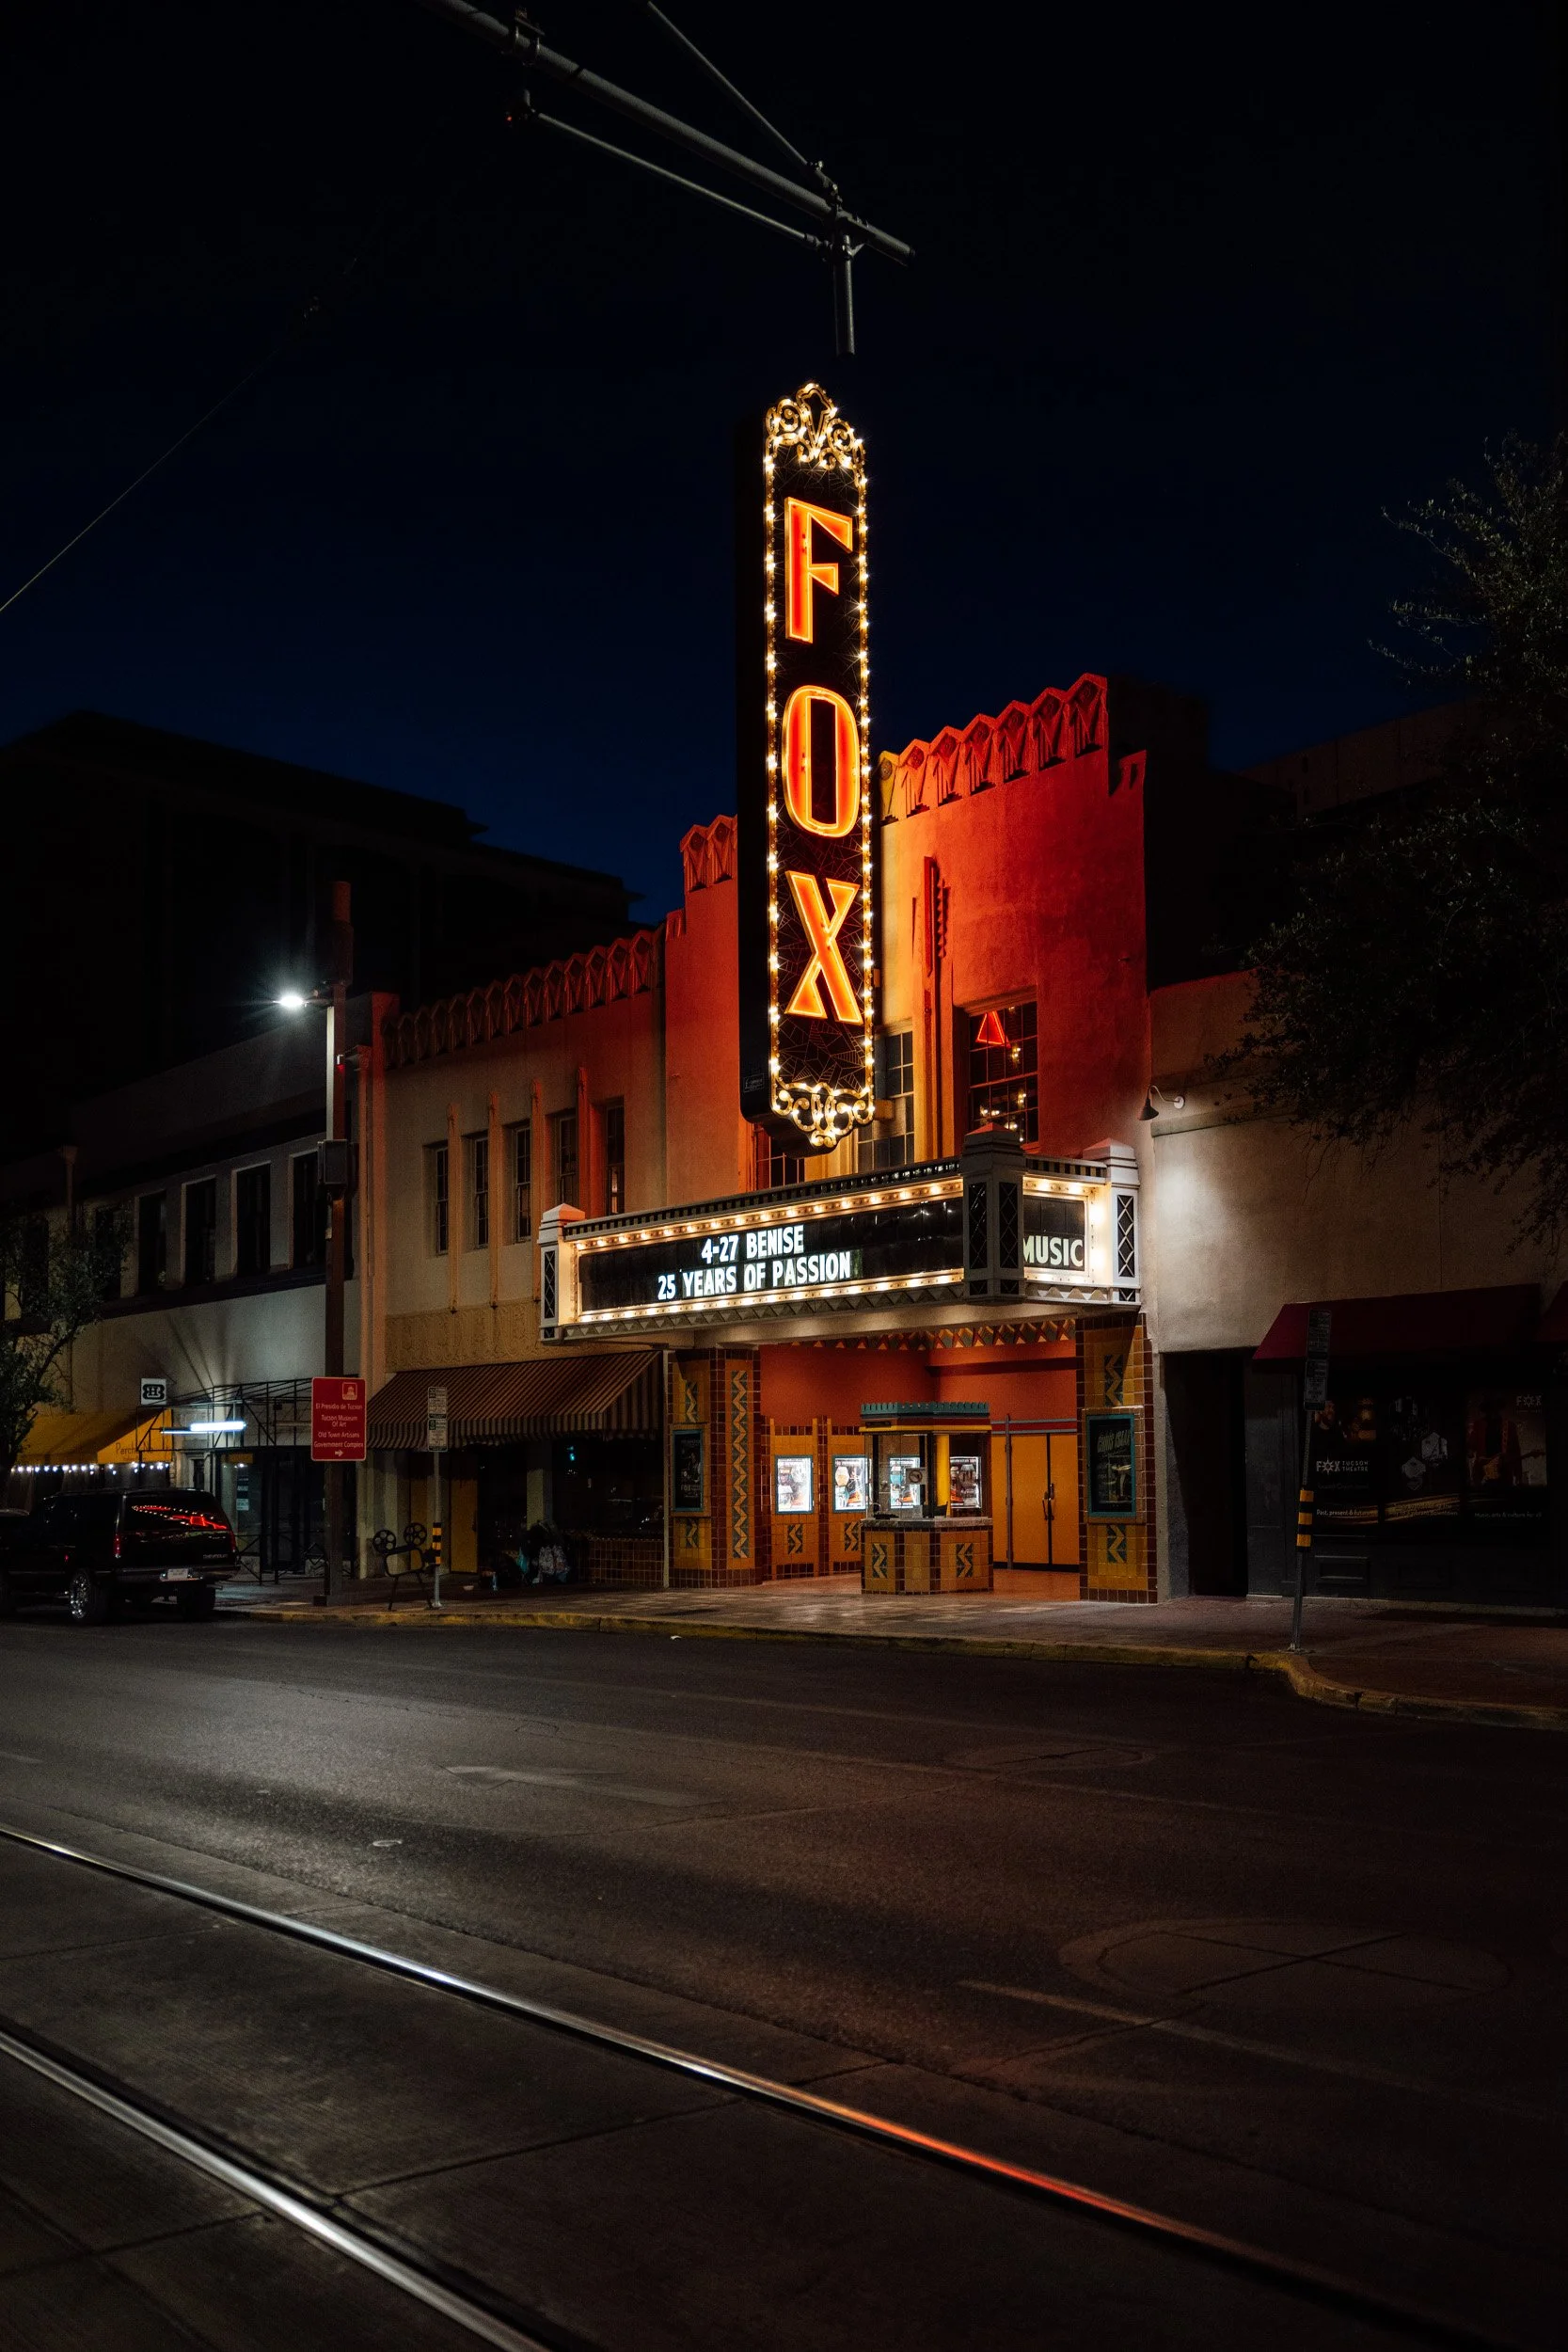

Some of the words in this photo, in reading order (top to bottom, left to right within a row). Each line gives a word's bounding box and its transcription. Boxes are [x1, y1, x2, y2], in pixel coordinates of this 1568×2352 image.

[783, 496, 863, 1024] FOX
[701, 1234, 739, 1263] 4-27
[746, 1225, 804, 1259] BENISE
[1022, 1235, 1084, 1267] MUSIC
[657, 1274, 675, 1300] 25
[682, 1266, 736, 1297] YEARS
[744, 1262, 766, 1292] OF
[772, 1251, 851, 1287] PASSION
